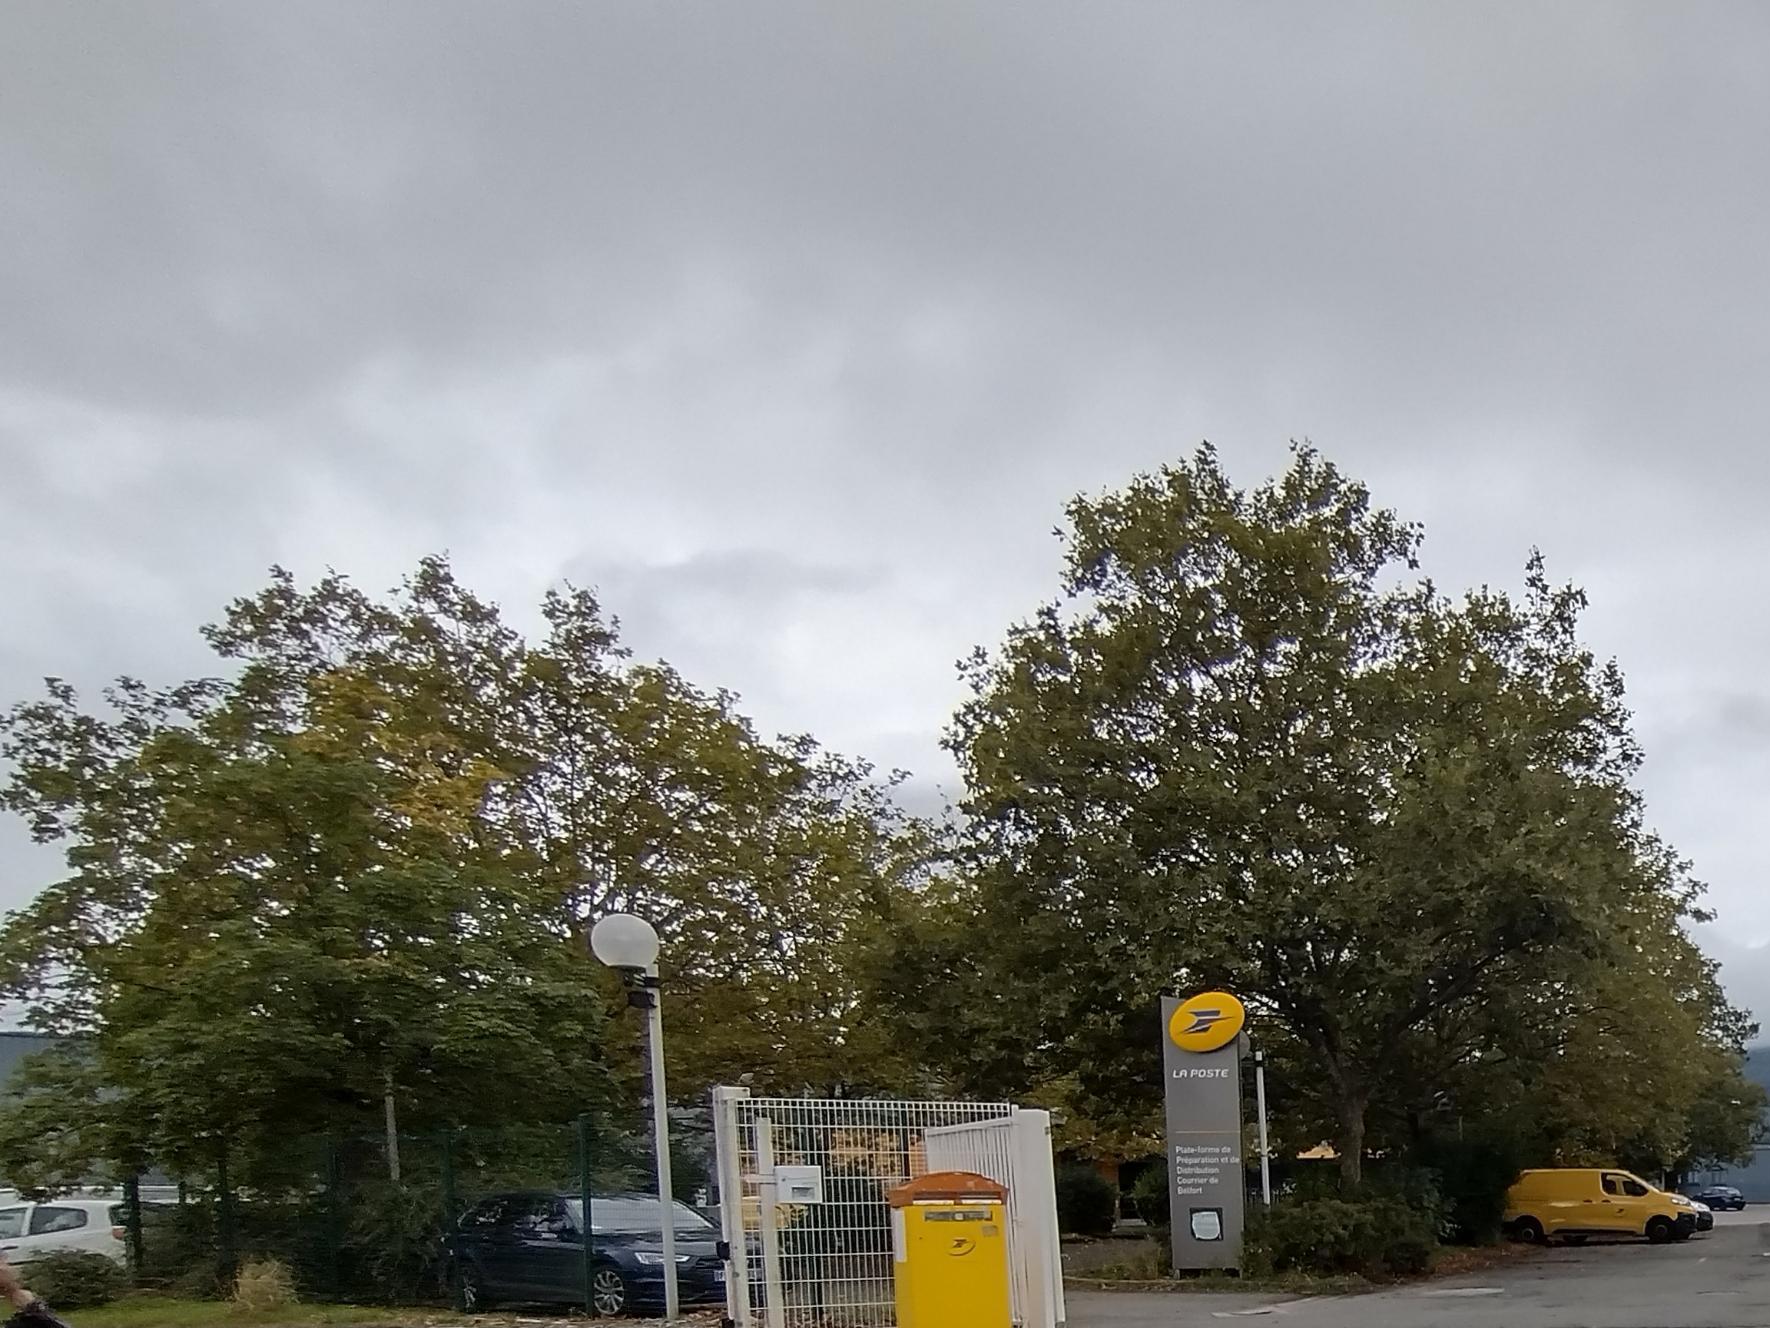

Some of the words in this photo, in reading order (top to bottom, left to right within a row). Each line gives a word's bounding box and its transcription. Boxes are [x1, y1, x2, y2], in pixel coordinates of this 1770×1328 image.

[1173, 1069, 1188, 1078] LA
[1190, 1069, 1229, 1078] POSTE
[1176, 1166, 1220, 1175] Distribution
[1177, 1176, 1208, 1185] Courrier
[1177, 1186, 1203, 1195] Belfort
